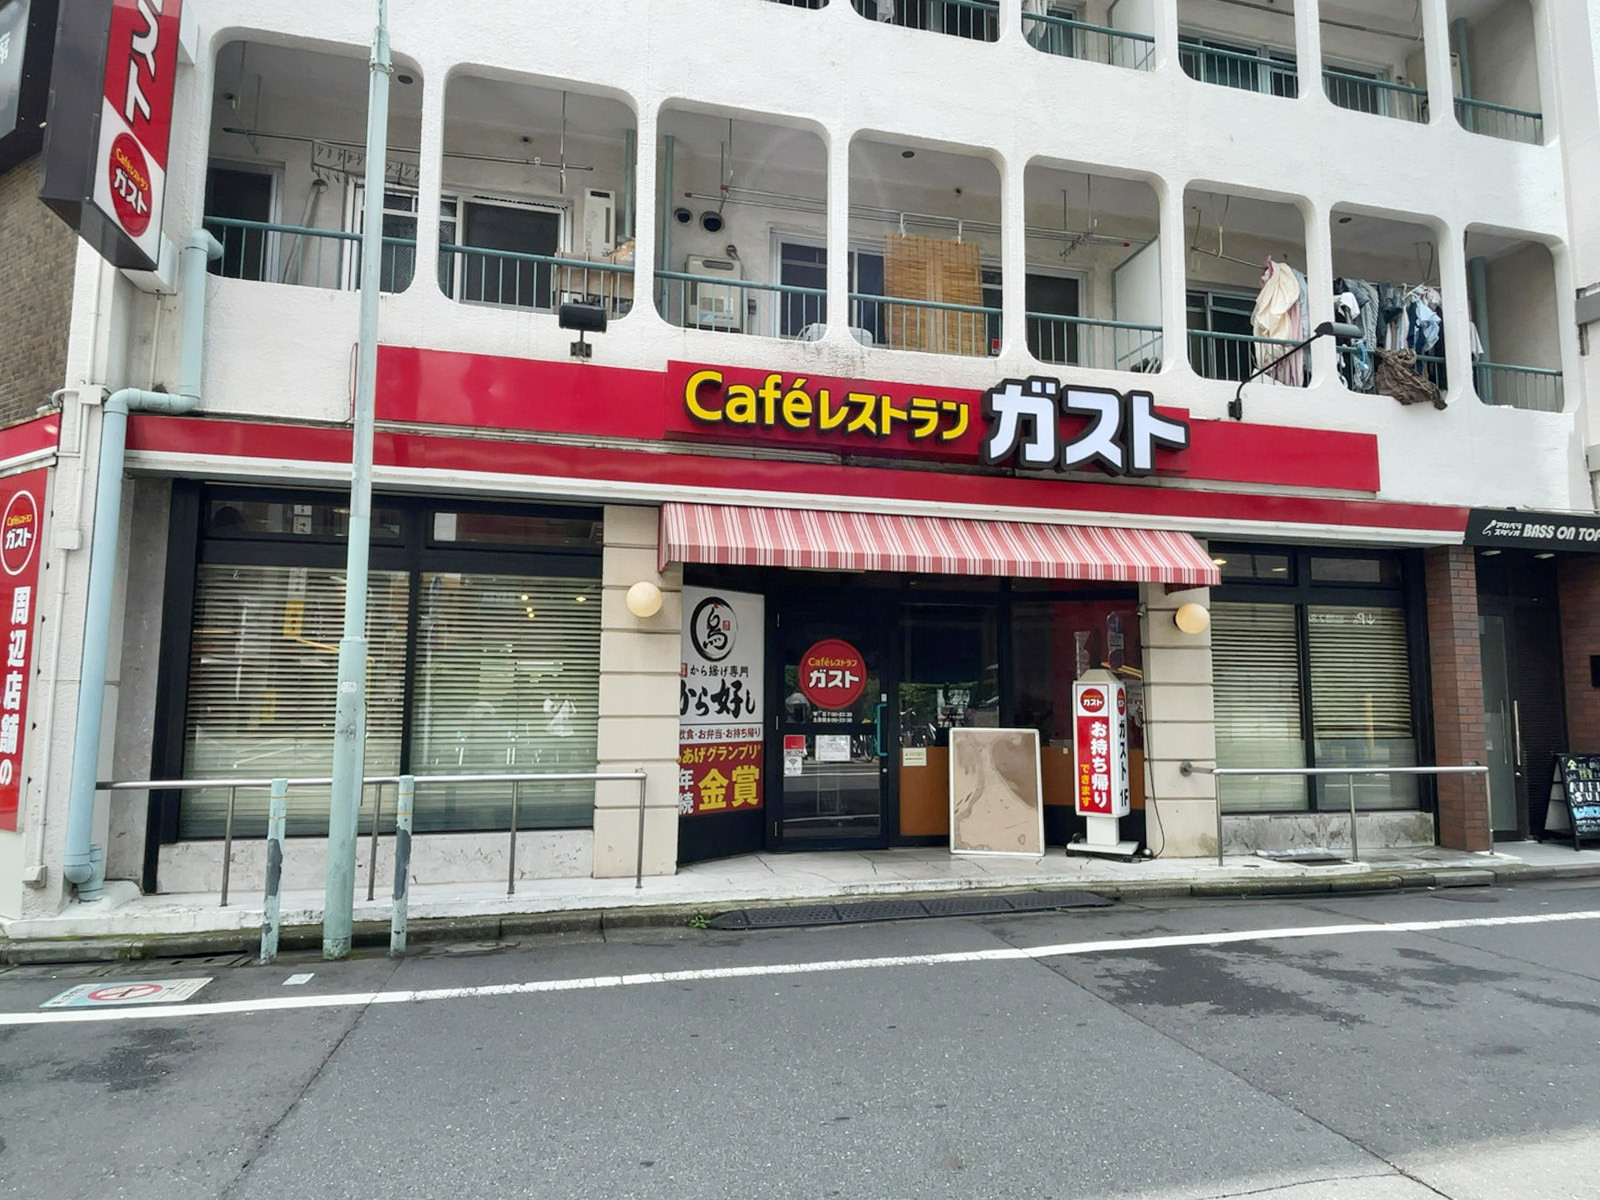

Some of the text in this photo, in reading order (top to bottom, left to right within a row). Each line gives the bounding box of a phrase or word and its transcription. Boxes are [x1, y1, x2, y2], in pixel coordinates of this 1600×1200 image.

[126, 0, 163, 126] スト
[114, 168, 148, 215] ガスト
[684, 370, 1188, 472] Caféレストラン ガスト
[5, 526, 33, 550] ガスト
[1522, 523, 1556, 539] BASS
[0, 585, 31, 786] 周辺店舗の
[808, 669, 860, 689] ガスト
[1083, 698, 1104, 707] ガスト
[1090, 721, 1109, 809] お持ち帰り
[1119, 720, 1127, 781] ガスト
[698, 764, 760, 811] 金賞
[1080, 763, 1091, 808] できます
